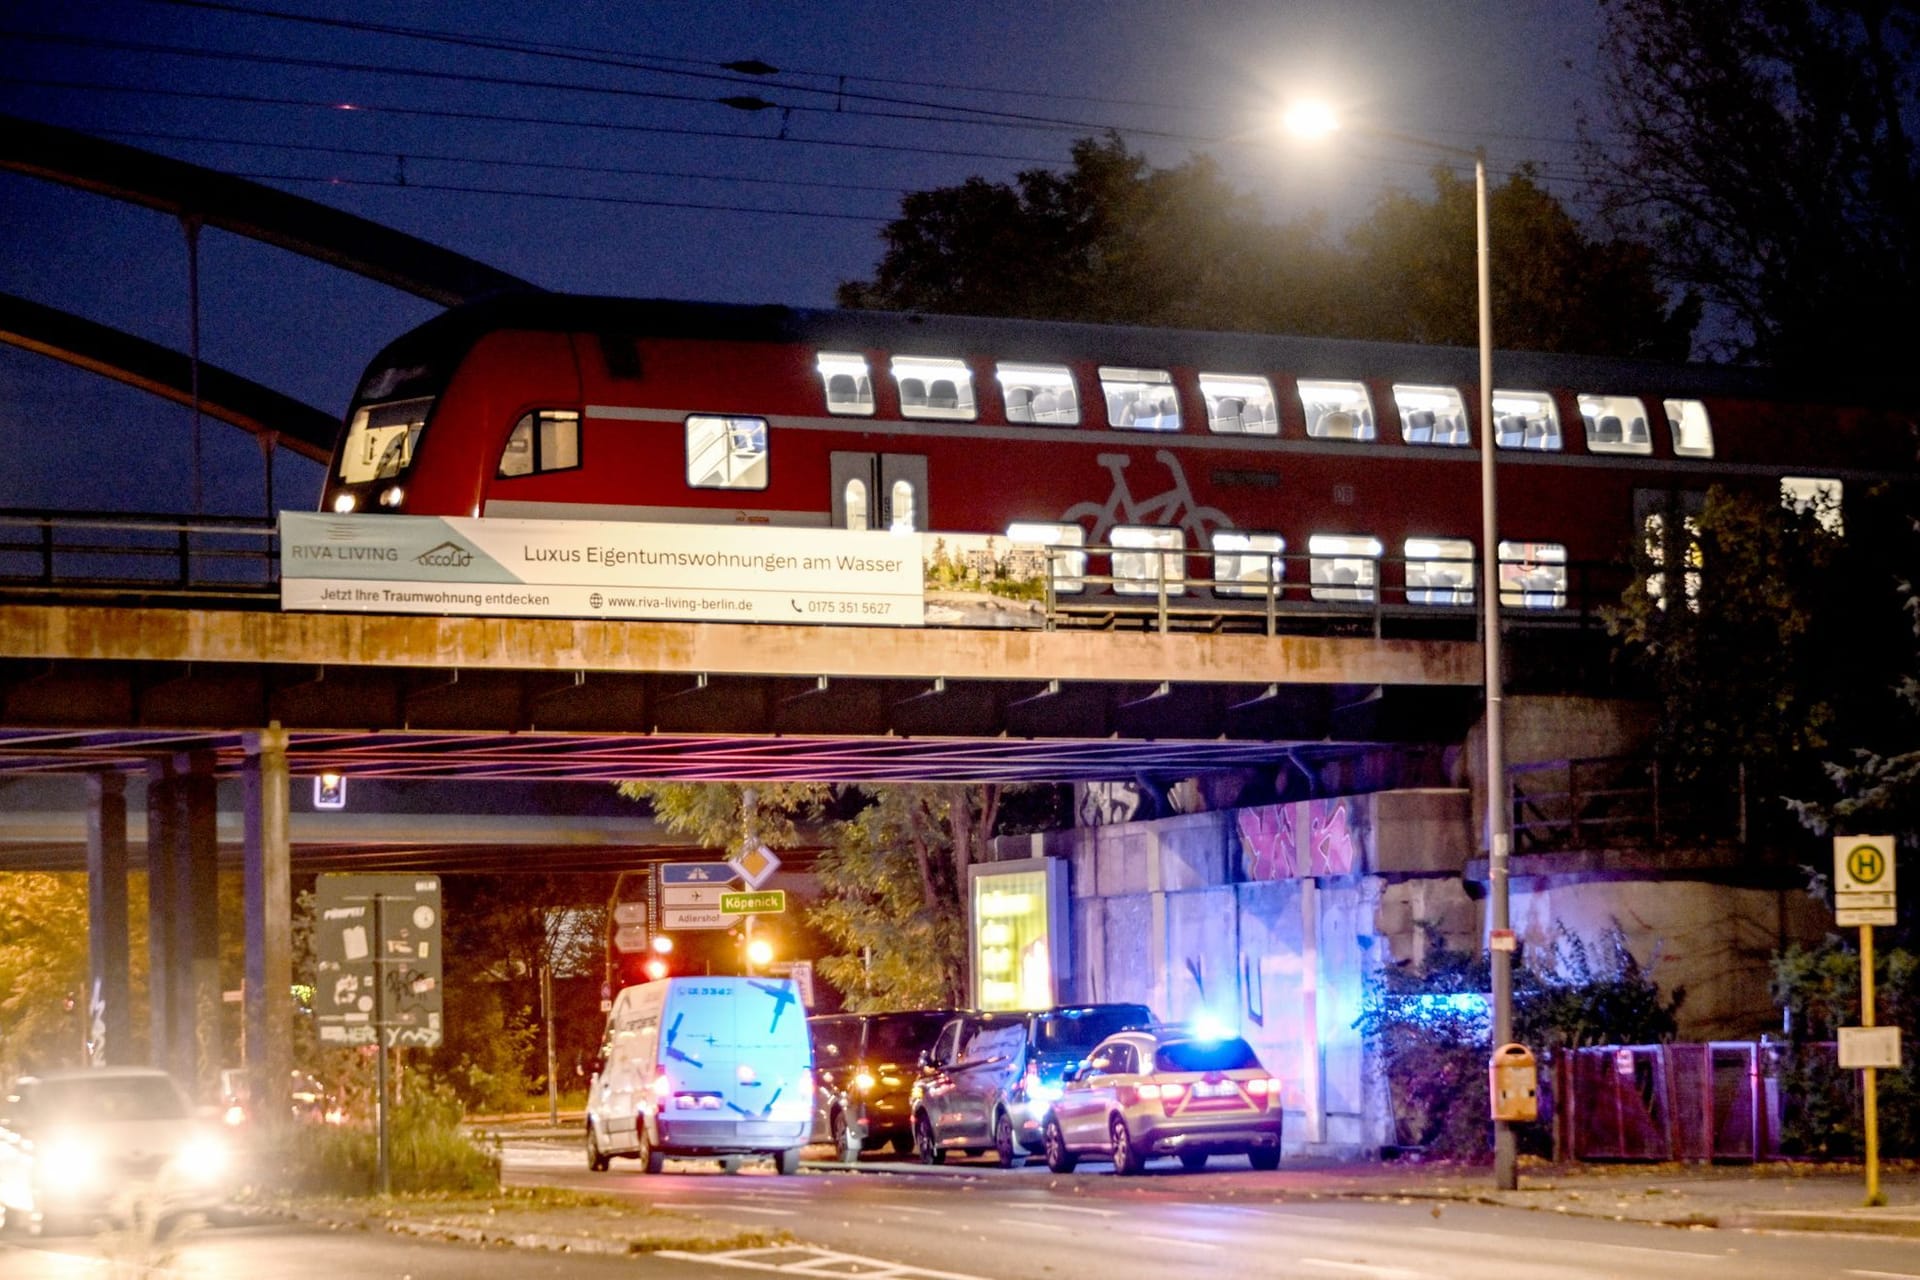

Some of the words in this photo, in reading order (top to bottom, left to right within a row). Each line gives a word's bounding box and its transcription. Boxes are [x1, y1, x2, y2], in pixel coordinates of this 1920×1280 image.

[291, 545, 333, 559] RIVA
[338, 547, 399, 561] LIVING
[525, 545, 581, 562] Luxus
[586, 547, 797, 571] Eigentumswohnungen
[803, 556, 831, 570] am
[836, 555, 902, 572] Wasser
[320, 588, 352, 601] Jetzt
[355, 589, 380, 601] Ihre
[382, 590, 482, 606] Traumwohnung
[485, 593, 550, 605] entdecken
[608, 595, 753, 611] www.riva-living-berlin.de
[808, 600, 835, 613] 0175
[838, 602, 859, 614] 351
[862, 602, 892, 615] 5627
[1857, 854, 1876, 876] H
[725, 896, 778, 911] Köpenick
[678, 913, 720, 923] Adlershof
